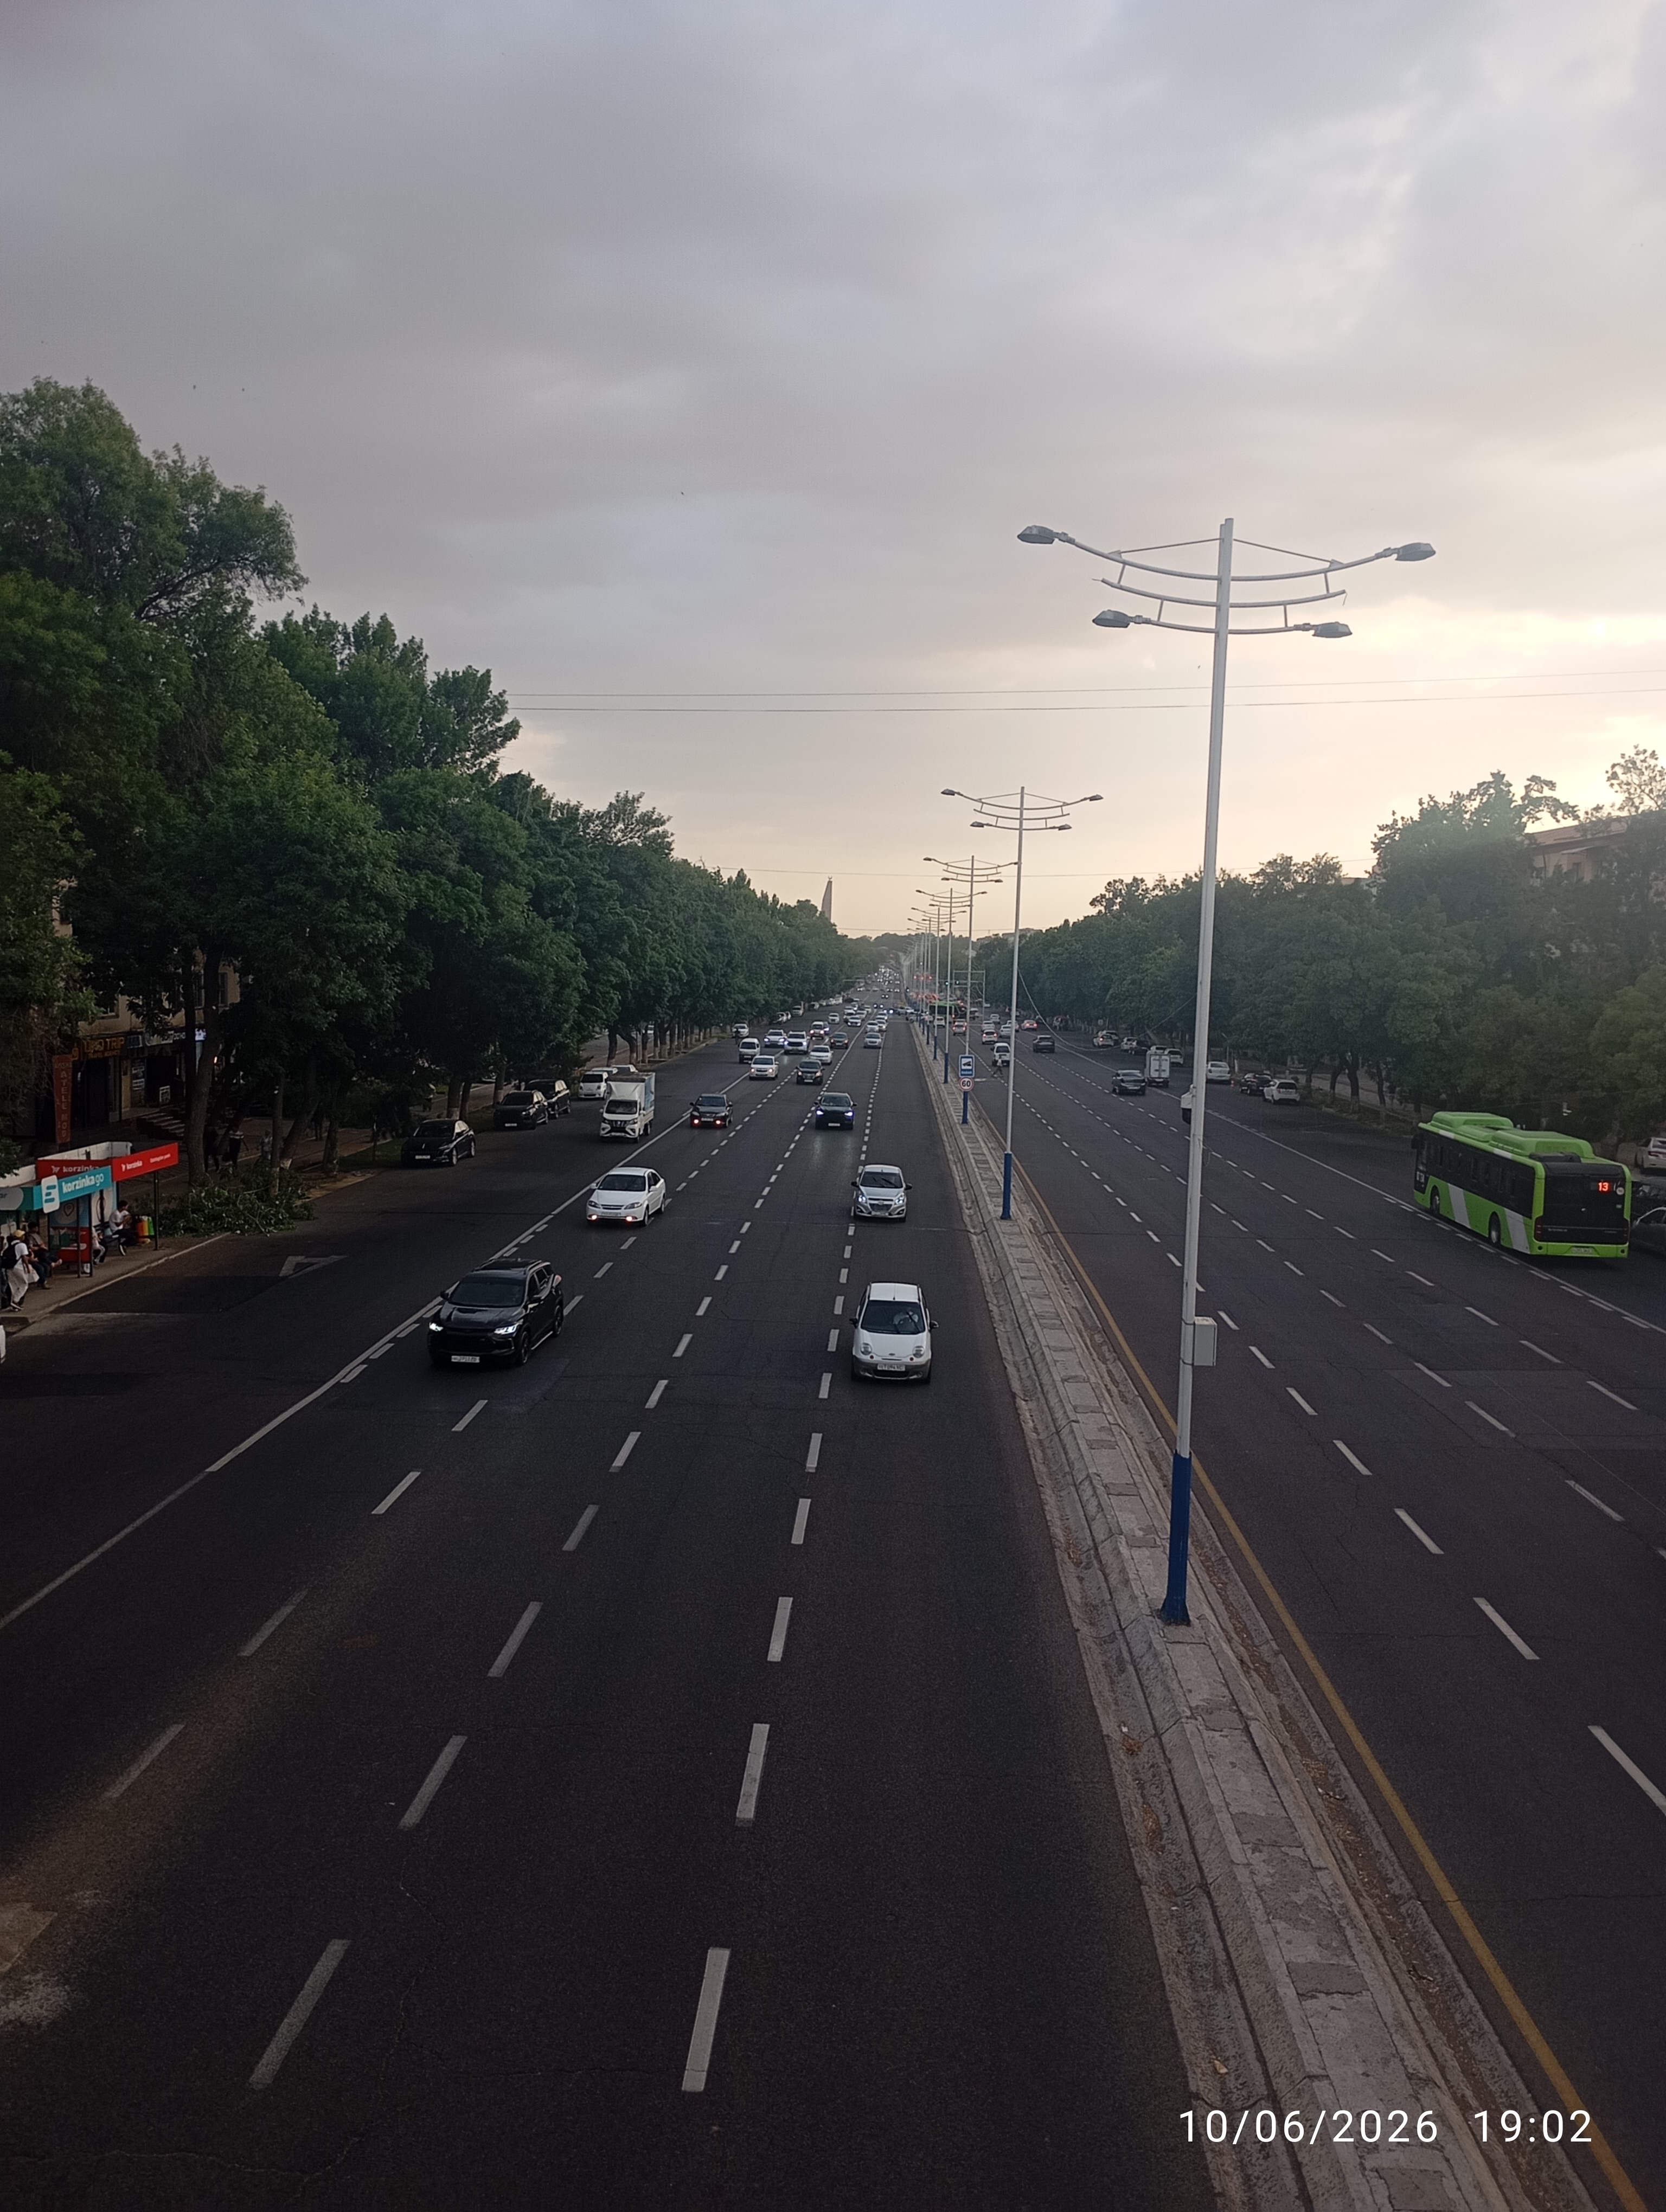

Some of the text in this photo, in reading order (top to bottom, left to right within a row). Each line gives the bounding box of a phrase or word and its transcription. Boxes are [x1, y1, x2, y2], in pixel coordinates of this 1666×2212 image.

[105, 1037, 125, 1050] TRIP
[62, 1174, 95, 1194] korzinka
[1598, 1182, 1609, 1192] 13
